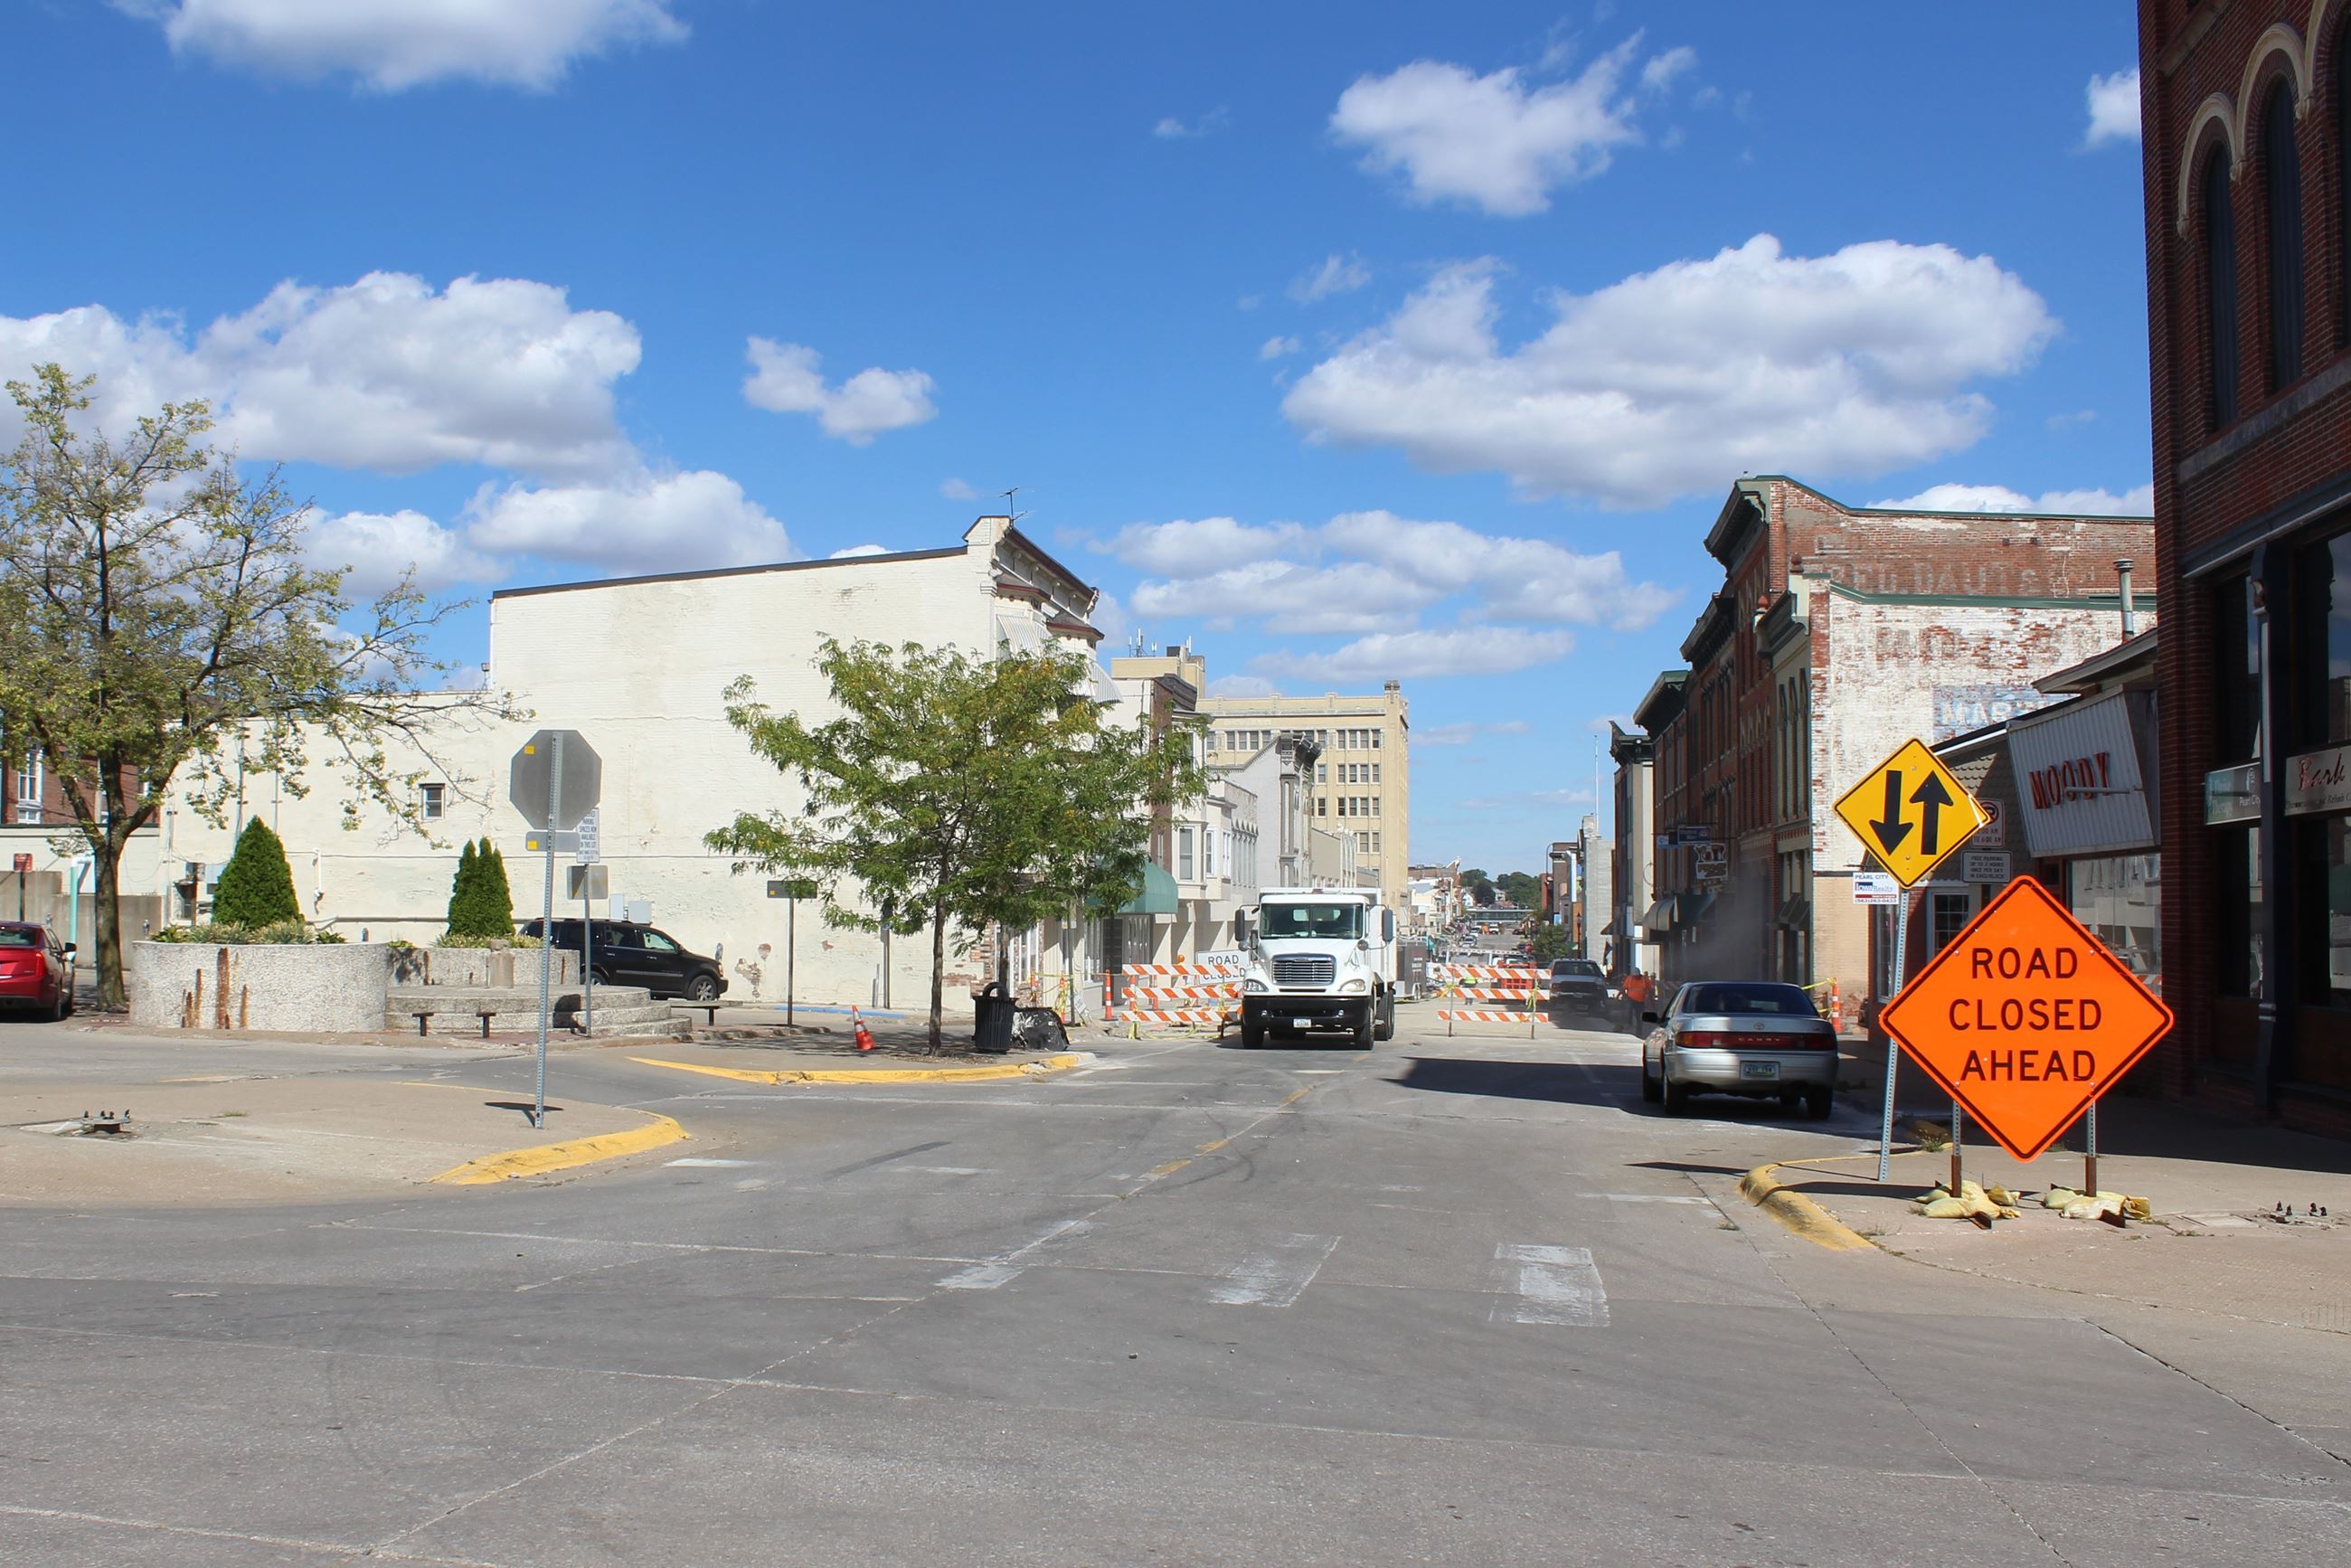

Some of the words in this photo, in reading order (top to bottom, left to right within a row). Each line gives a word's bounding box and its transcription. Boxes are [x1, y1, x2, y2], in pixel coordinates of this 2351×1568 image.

[2028, 751, 2110, 810] MOODY
[1207, 954, 1240, 966] ROAD
[1971, 947, 2078, 979] ROAD
[1948, 998, 2102, 1031] CLOSED
[1959, 1050, 2097, 1082] AHEAD
